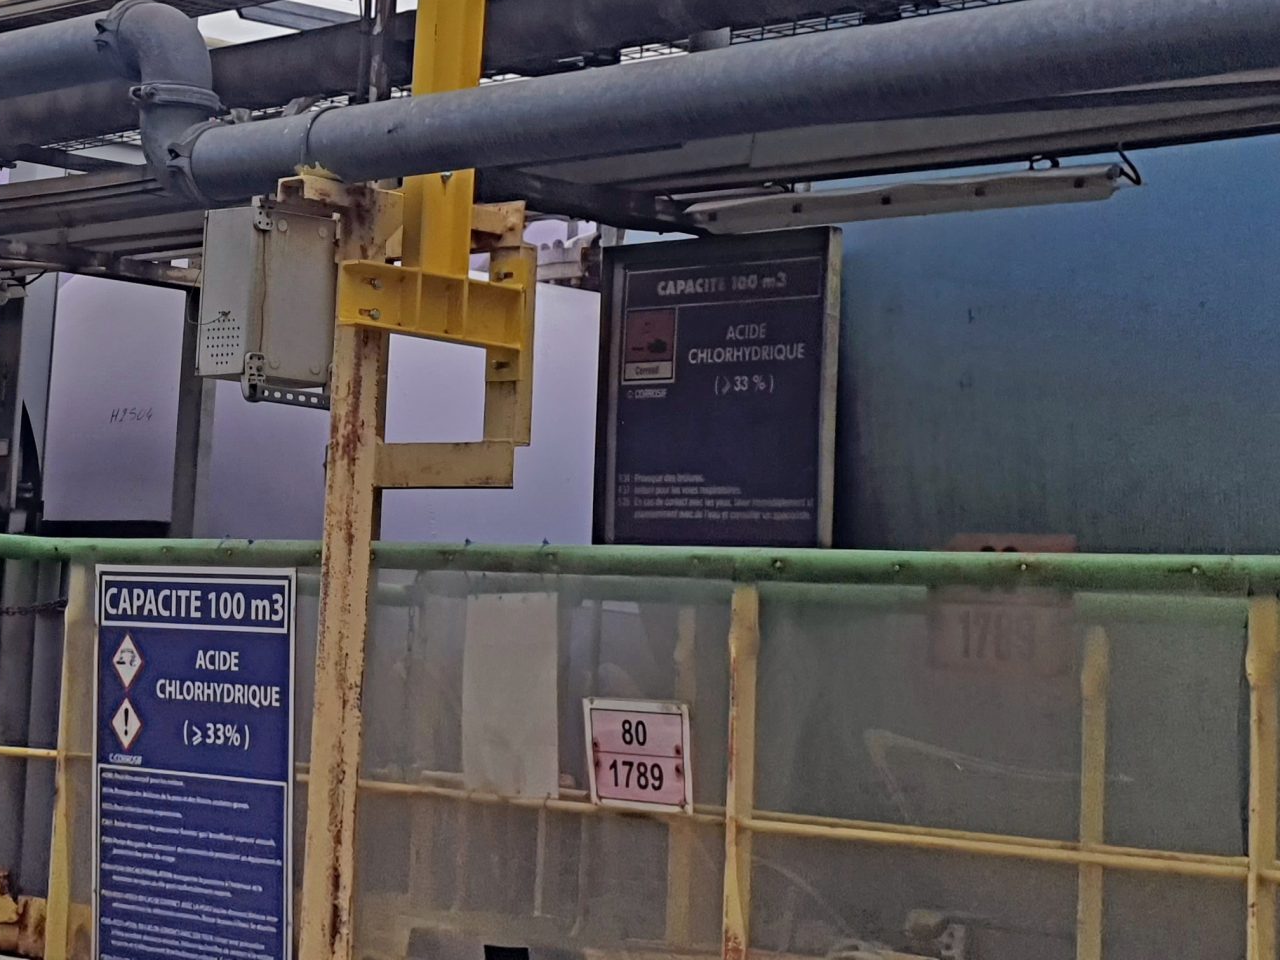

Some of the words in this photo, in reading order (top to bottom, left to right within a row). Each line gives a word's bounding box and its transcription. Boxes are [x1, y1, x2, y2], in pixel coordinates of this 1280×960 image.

[726, 323, 767, 341] ACIDE
[688, 343, 806, 365] CHLORHYDRIQUE
[105, 587, 202, 618] CAPACITE
[208, 591, 246, 620] 100
[250, 593, 284, 622] m3
[195, 649, 240, 672] ACIDE
[156, 678, 281, 708] CHLORHYDRIQUE
[621, 719, 647, 746] 80
[609, 759, 664, 791] 1789
